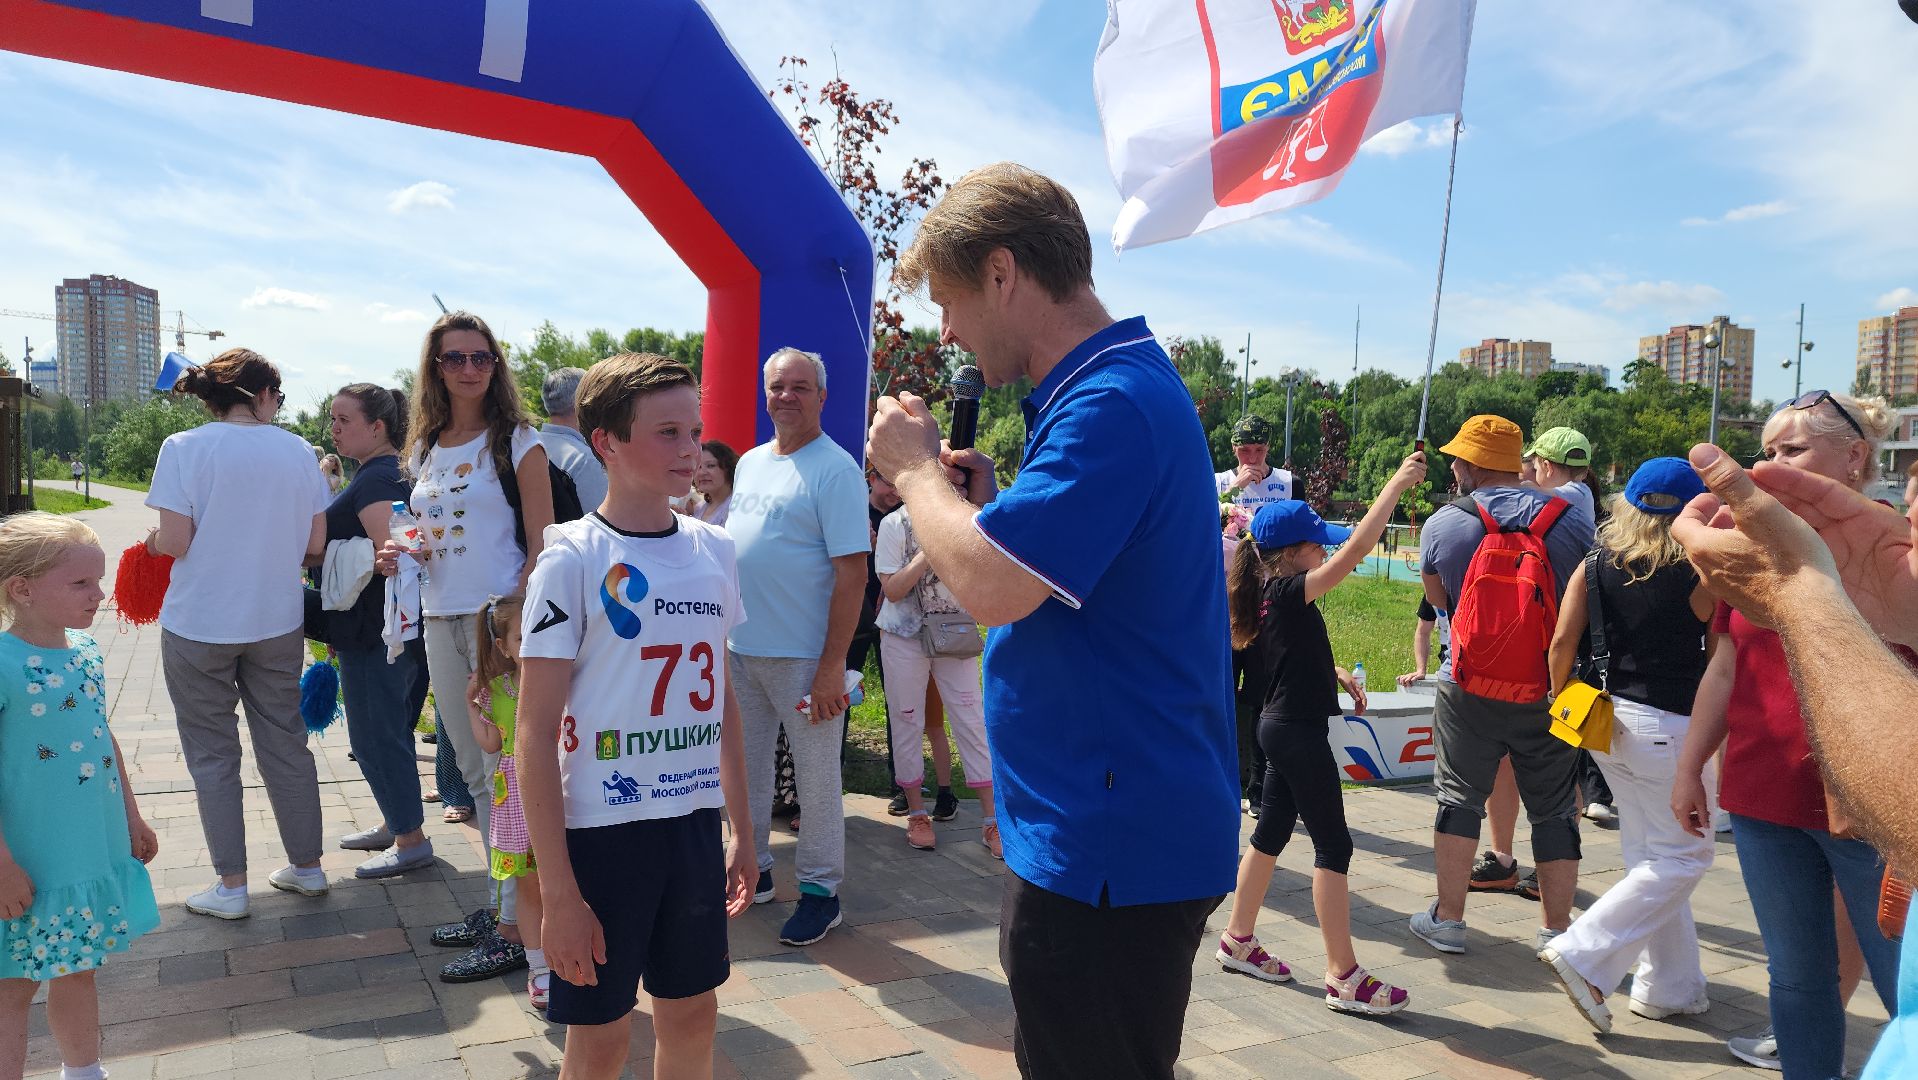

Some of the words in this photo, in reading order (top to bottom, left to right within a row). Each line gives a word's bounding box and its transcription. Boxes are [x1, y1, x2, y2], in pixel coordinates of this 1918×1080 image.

[640, 641, 715, 717] 73
[1465, 675, 1541, 704] NIKE
[1398, 726, 1437, 763] 2
